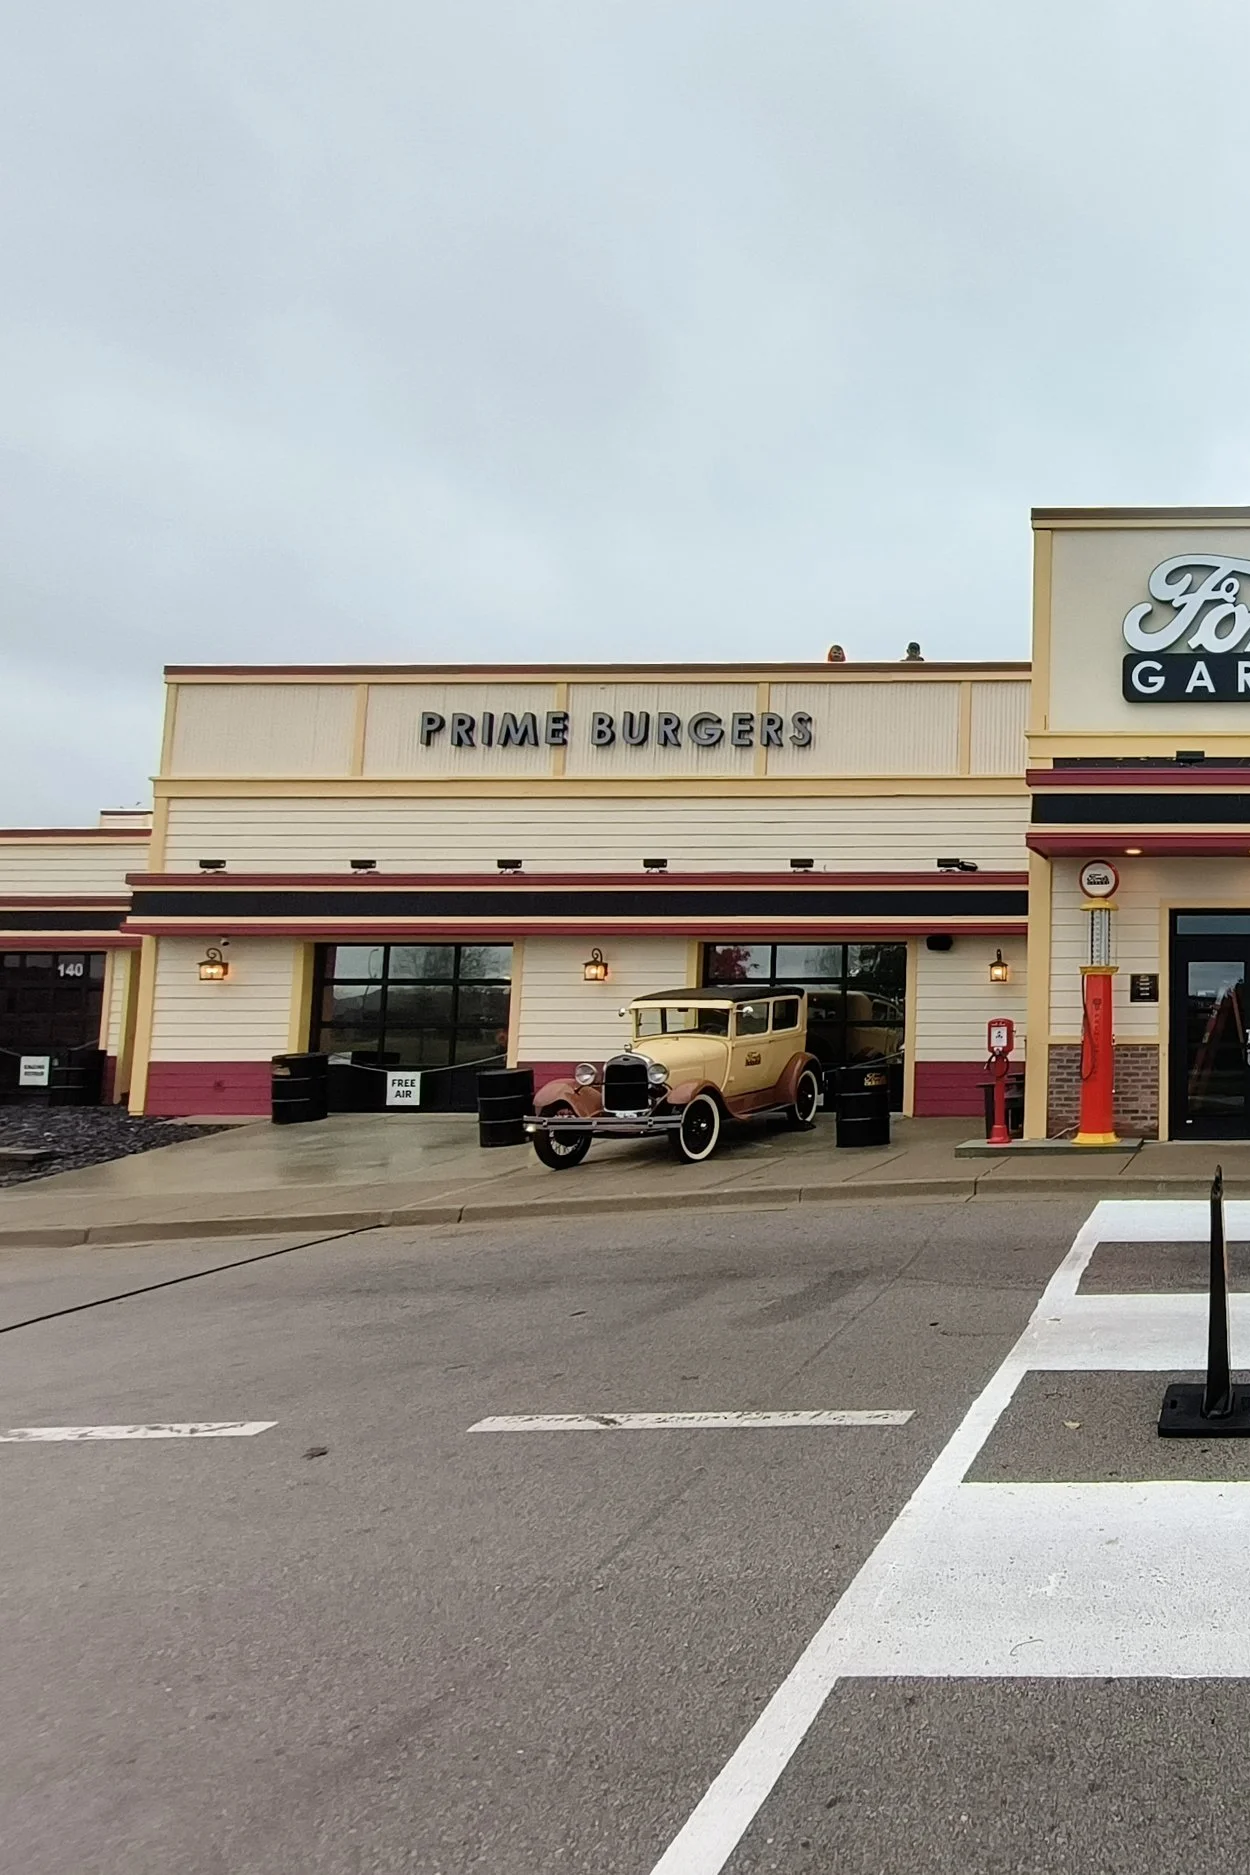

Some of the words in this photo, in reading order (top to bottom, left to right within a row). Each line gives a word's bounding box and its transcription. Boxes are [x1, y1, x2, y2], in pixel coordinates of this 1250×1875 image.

[420, 710, 570, 747] PRIME
[590, 711, 813, 748] BURGERS
[57, 963, 84, 977] 140
[391, 1078, 416, 1088] FREE
[394, 1090, 412, 1098] AIR
